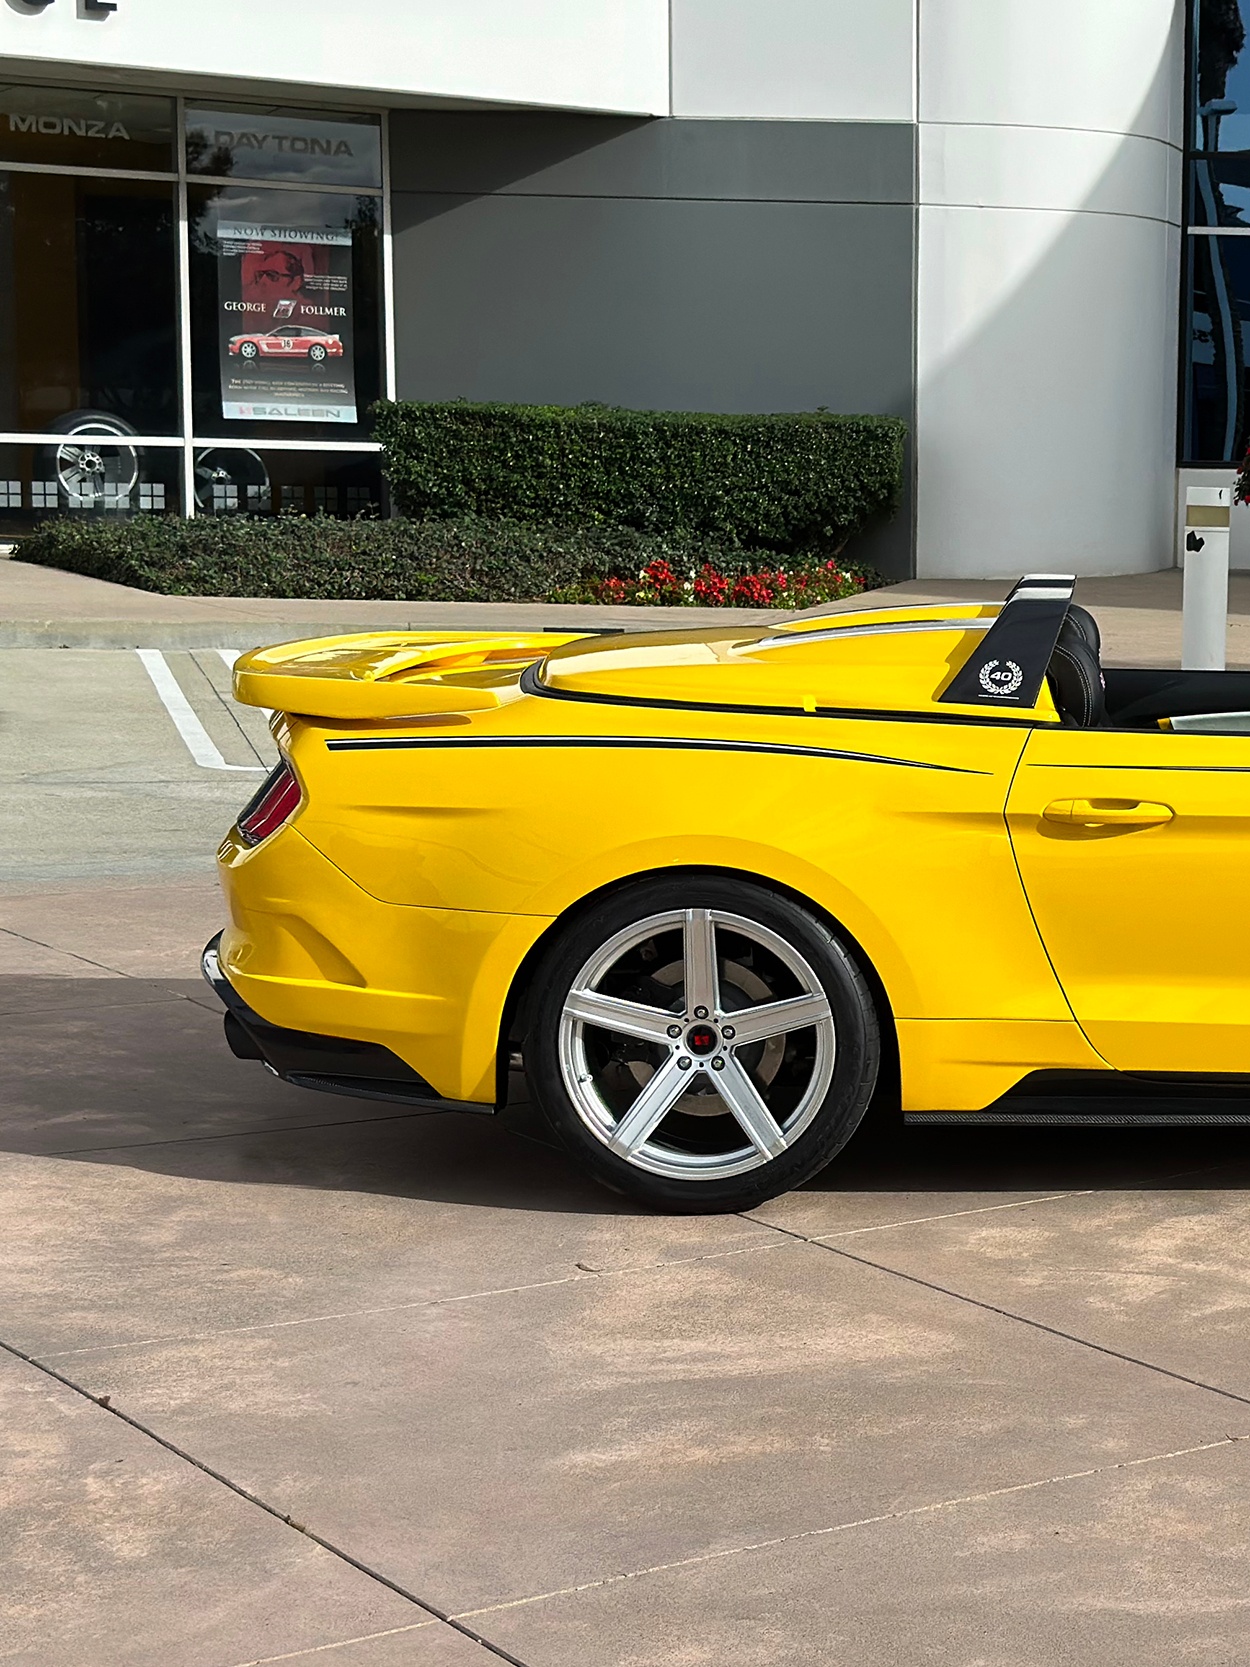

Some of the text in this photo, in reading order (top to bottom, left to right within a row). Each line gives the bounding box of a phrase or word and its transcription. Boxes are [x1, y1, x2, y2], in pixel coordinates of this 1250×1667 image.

[9, 114, 130, 141] MONZA
[214, 130, 354, 157] DAYTONA
[233, 226, 264, 238] NOW
[224, 301, 346, 316] GEORGE FOLLMER
[252, 407, 340, 418] SALEEN
[990, 671, 1012, 681] 40
